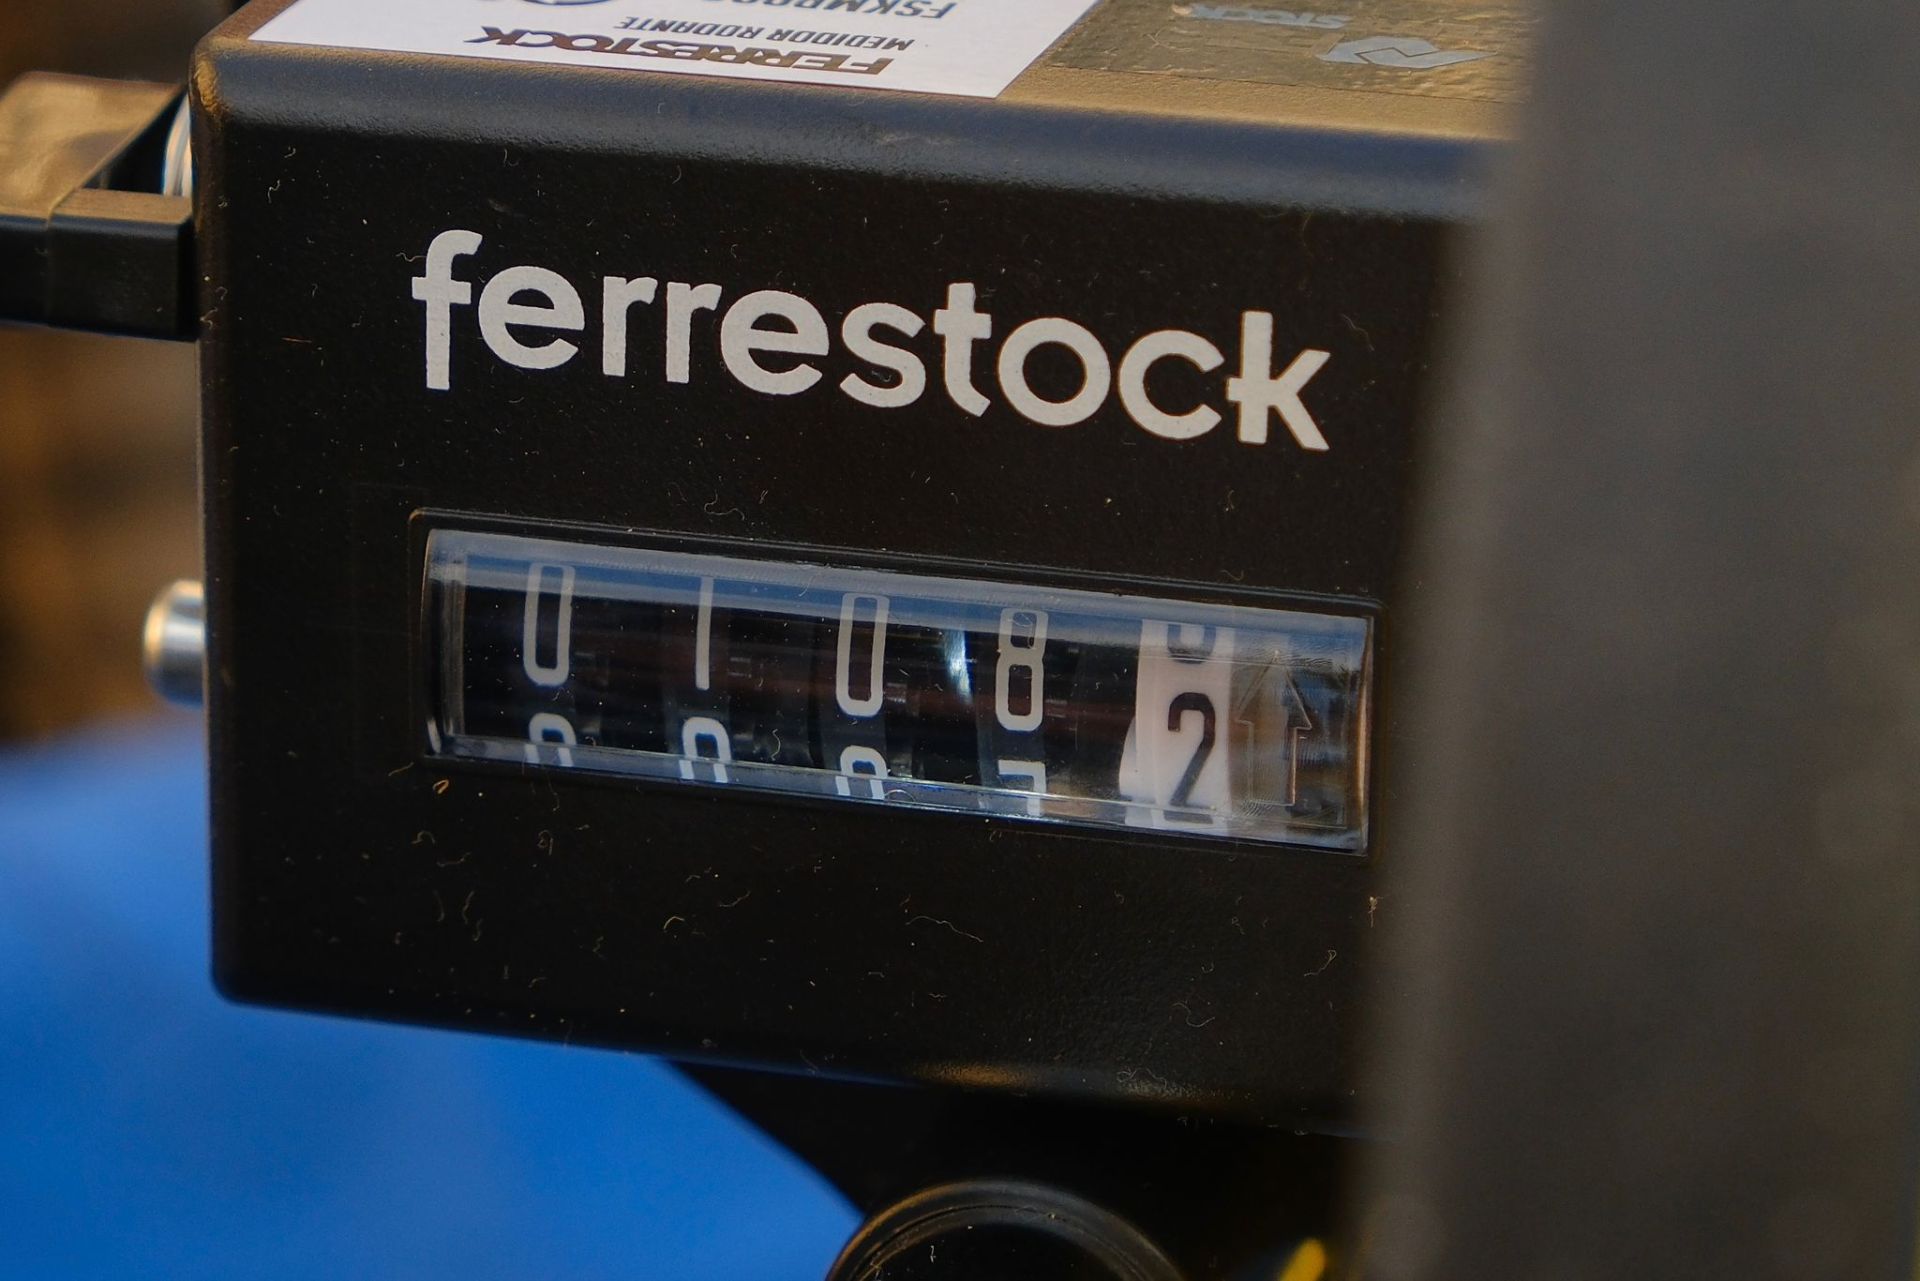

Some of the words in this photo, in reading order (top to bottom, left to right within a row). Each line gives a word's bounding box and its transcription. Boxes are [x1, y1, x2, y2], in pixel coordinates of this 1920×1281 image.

[613, 16, 767, 40] RODANTE
[771, 27, 916, 51] MEDIDOR
[463, 26, 895, 75] FERRESTOCK
[411, 229, 1331, 452] ferrestock
